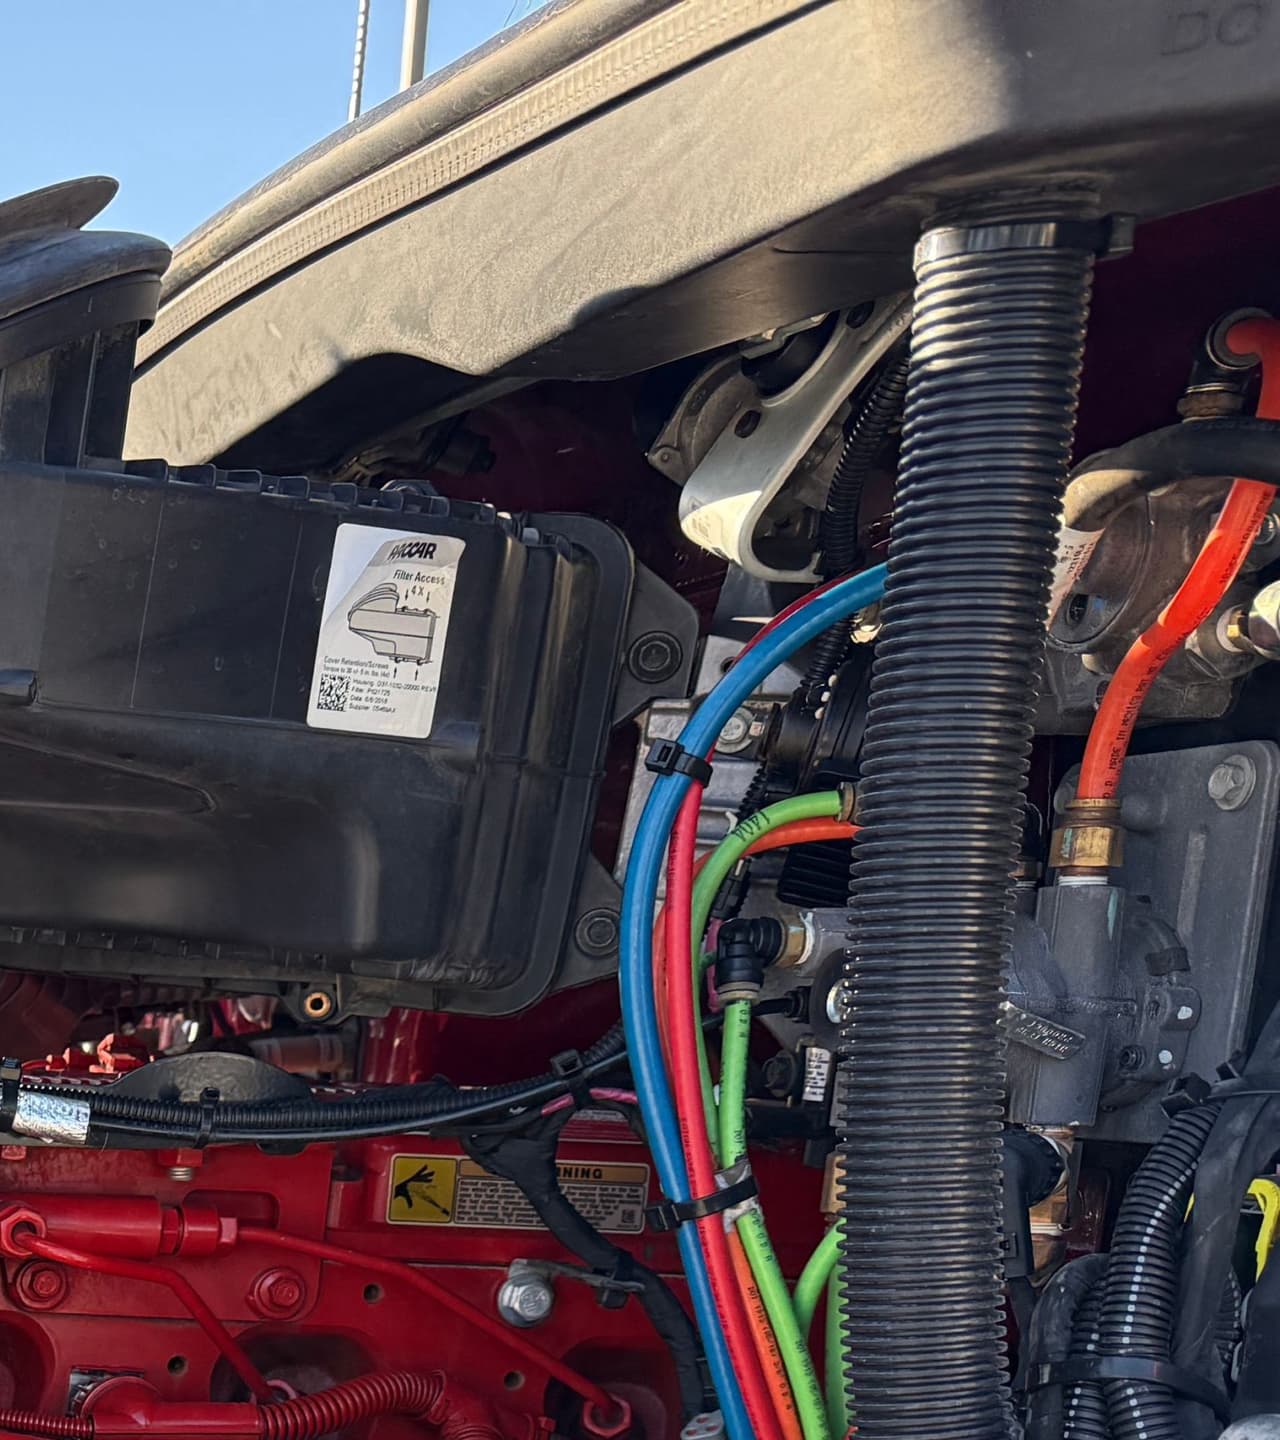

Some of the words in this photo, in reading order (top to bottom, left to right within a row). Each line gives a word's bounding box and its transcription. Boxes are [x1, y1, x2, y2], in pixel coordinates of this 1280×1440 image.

[387, 542, 437, 560] PACCAR
[393, 569, 414, 581] Filter
[415, 572, 446, 585] Access
[559, 1166, 604, 1180] NING
